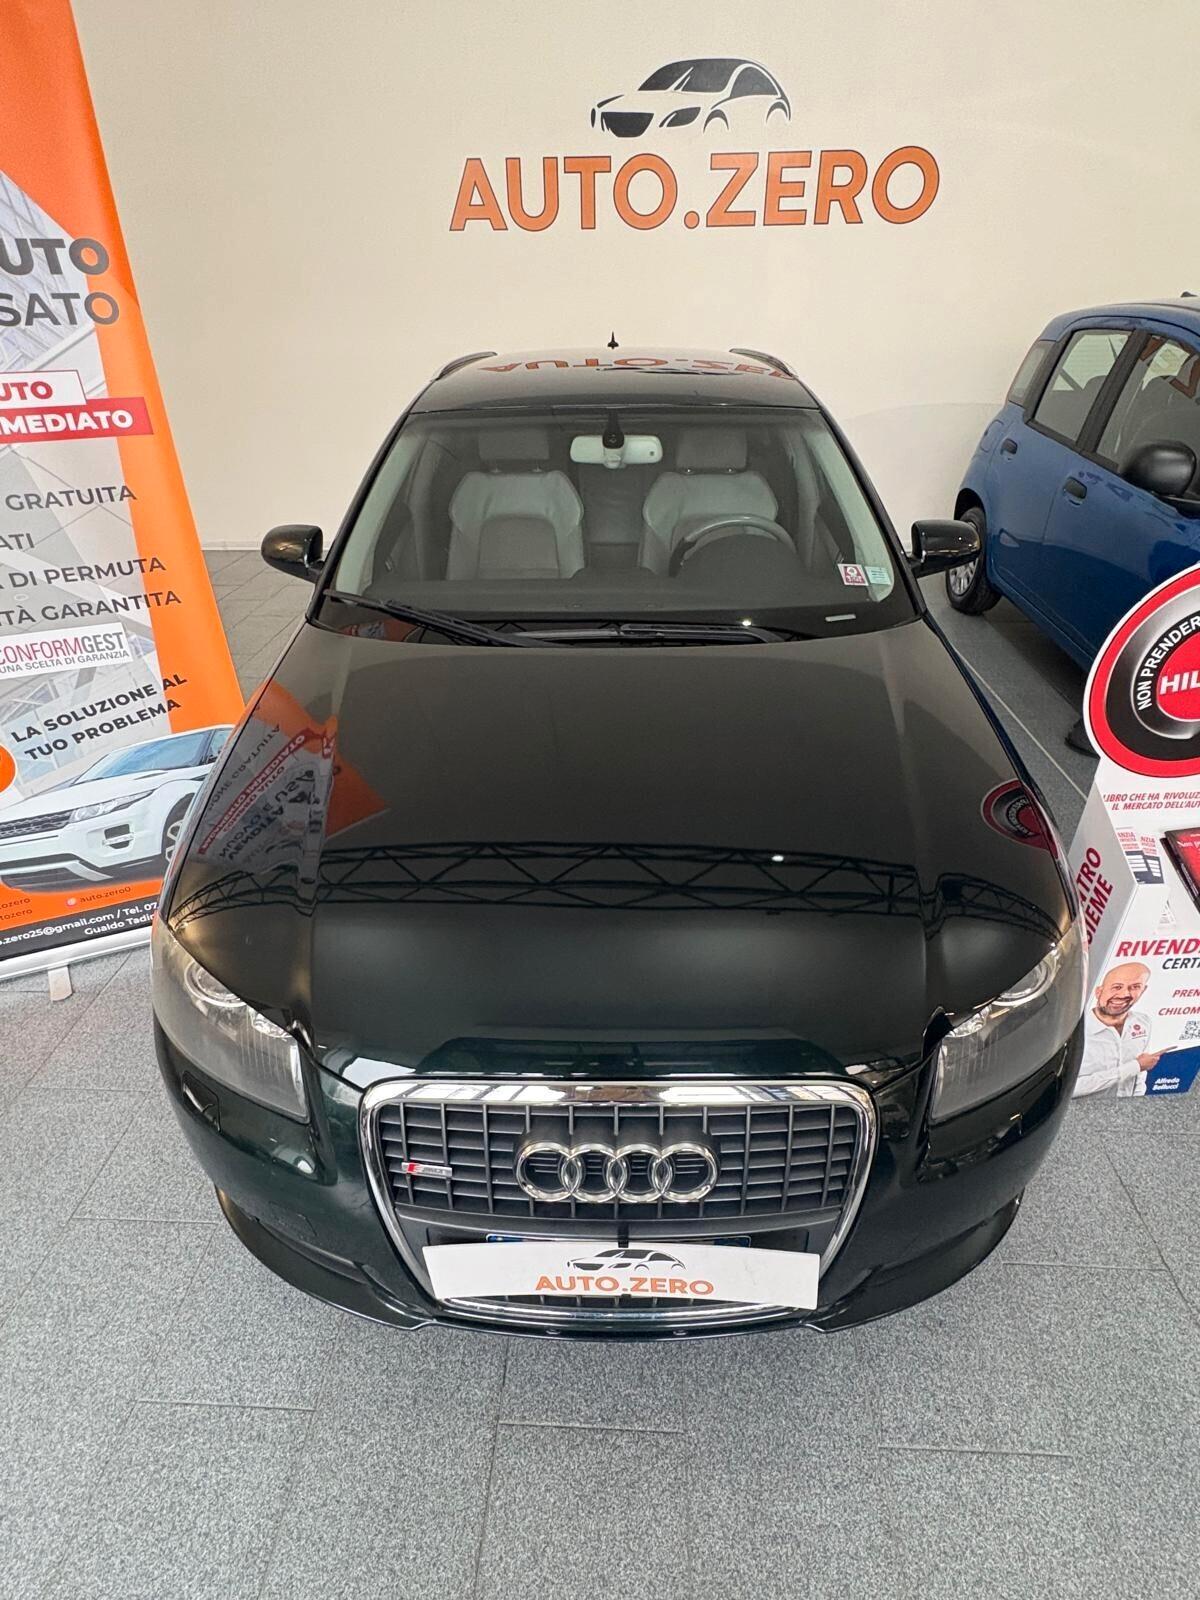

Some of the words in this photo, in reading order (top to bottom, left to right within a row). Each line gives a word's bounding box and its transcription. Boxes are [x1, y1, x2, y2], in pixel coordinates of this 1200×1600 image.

[449, 145, 940, 232] AUTO.ZERO
[0, 237, 110, 275] UTO
[0, 291, 120, 326] SATO
[0, 410, 133, 435] MEDIATO
[6, 485, 137, 511] GRATUITA
[8, 570, 38, 588] DI
[43, 556, 167, 585] PERMUTA
[41, 590, 182, 621] GARANTITA
[25, 657, 62, 671] SCELTA
[65, 656, 76, 665] DI
[77, 649, 130, 664] GARANZIA
[11, 725, 43, 743] LA
[43, 684, 158, 732] SOLUZIONE
[162, 674, 188, 690] AL
[1136, 680, 1153, 711] NON
[24, 738, 68, 760] TUO
[71, 699, 182, 744] PROBLEMA
[1123, 801, 1163, 810] MERCATO
[1129, 793, 1147, 801] CHE
[1147, 792, 1160, 801] HA
[122, 905, 143, 916] Tel.
[84, 921, 125, 936] Gualdo
[1116, 938, 1200, 957] RIVEND
[535, 1275, 715, 1296] AUTO.ZERO
